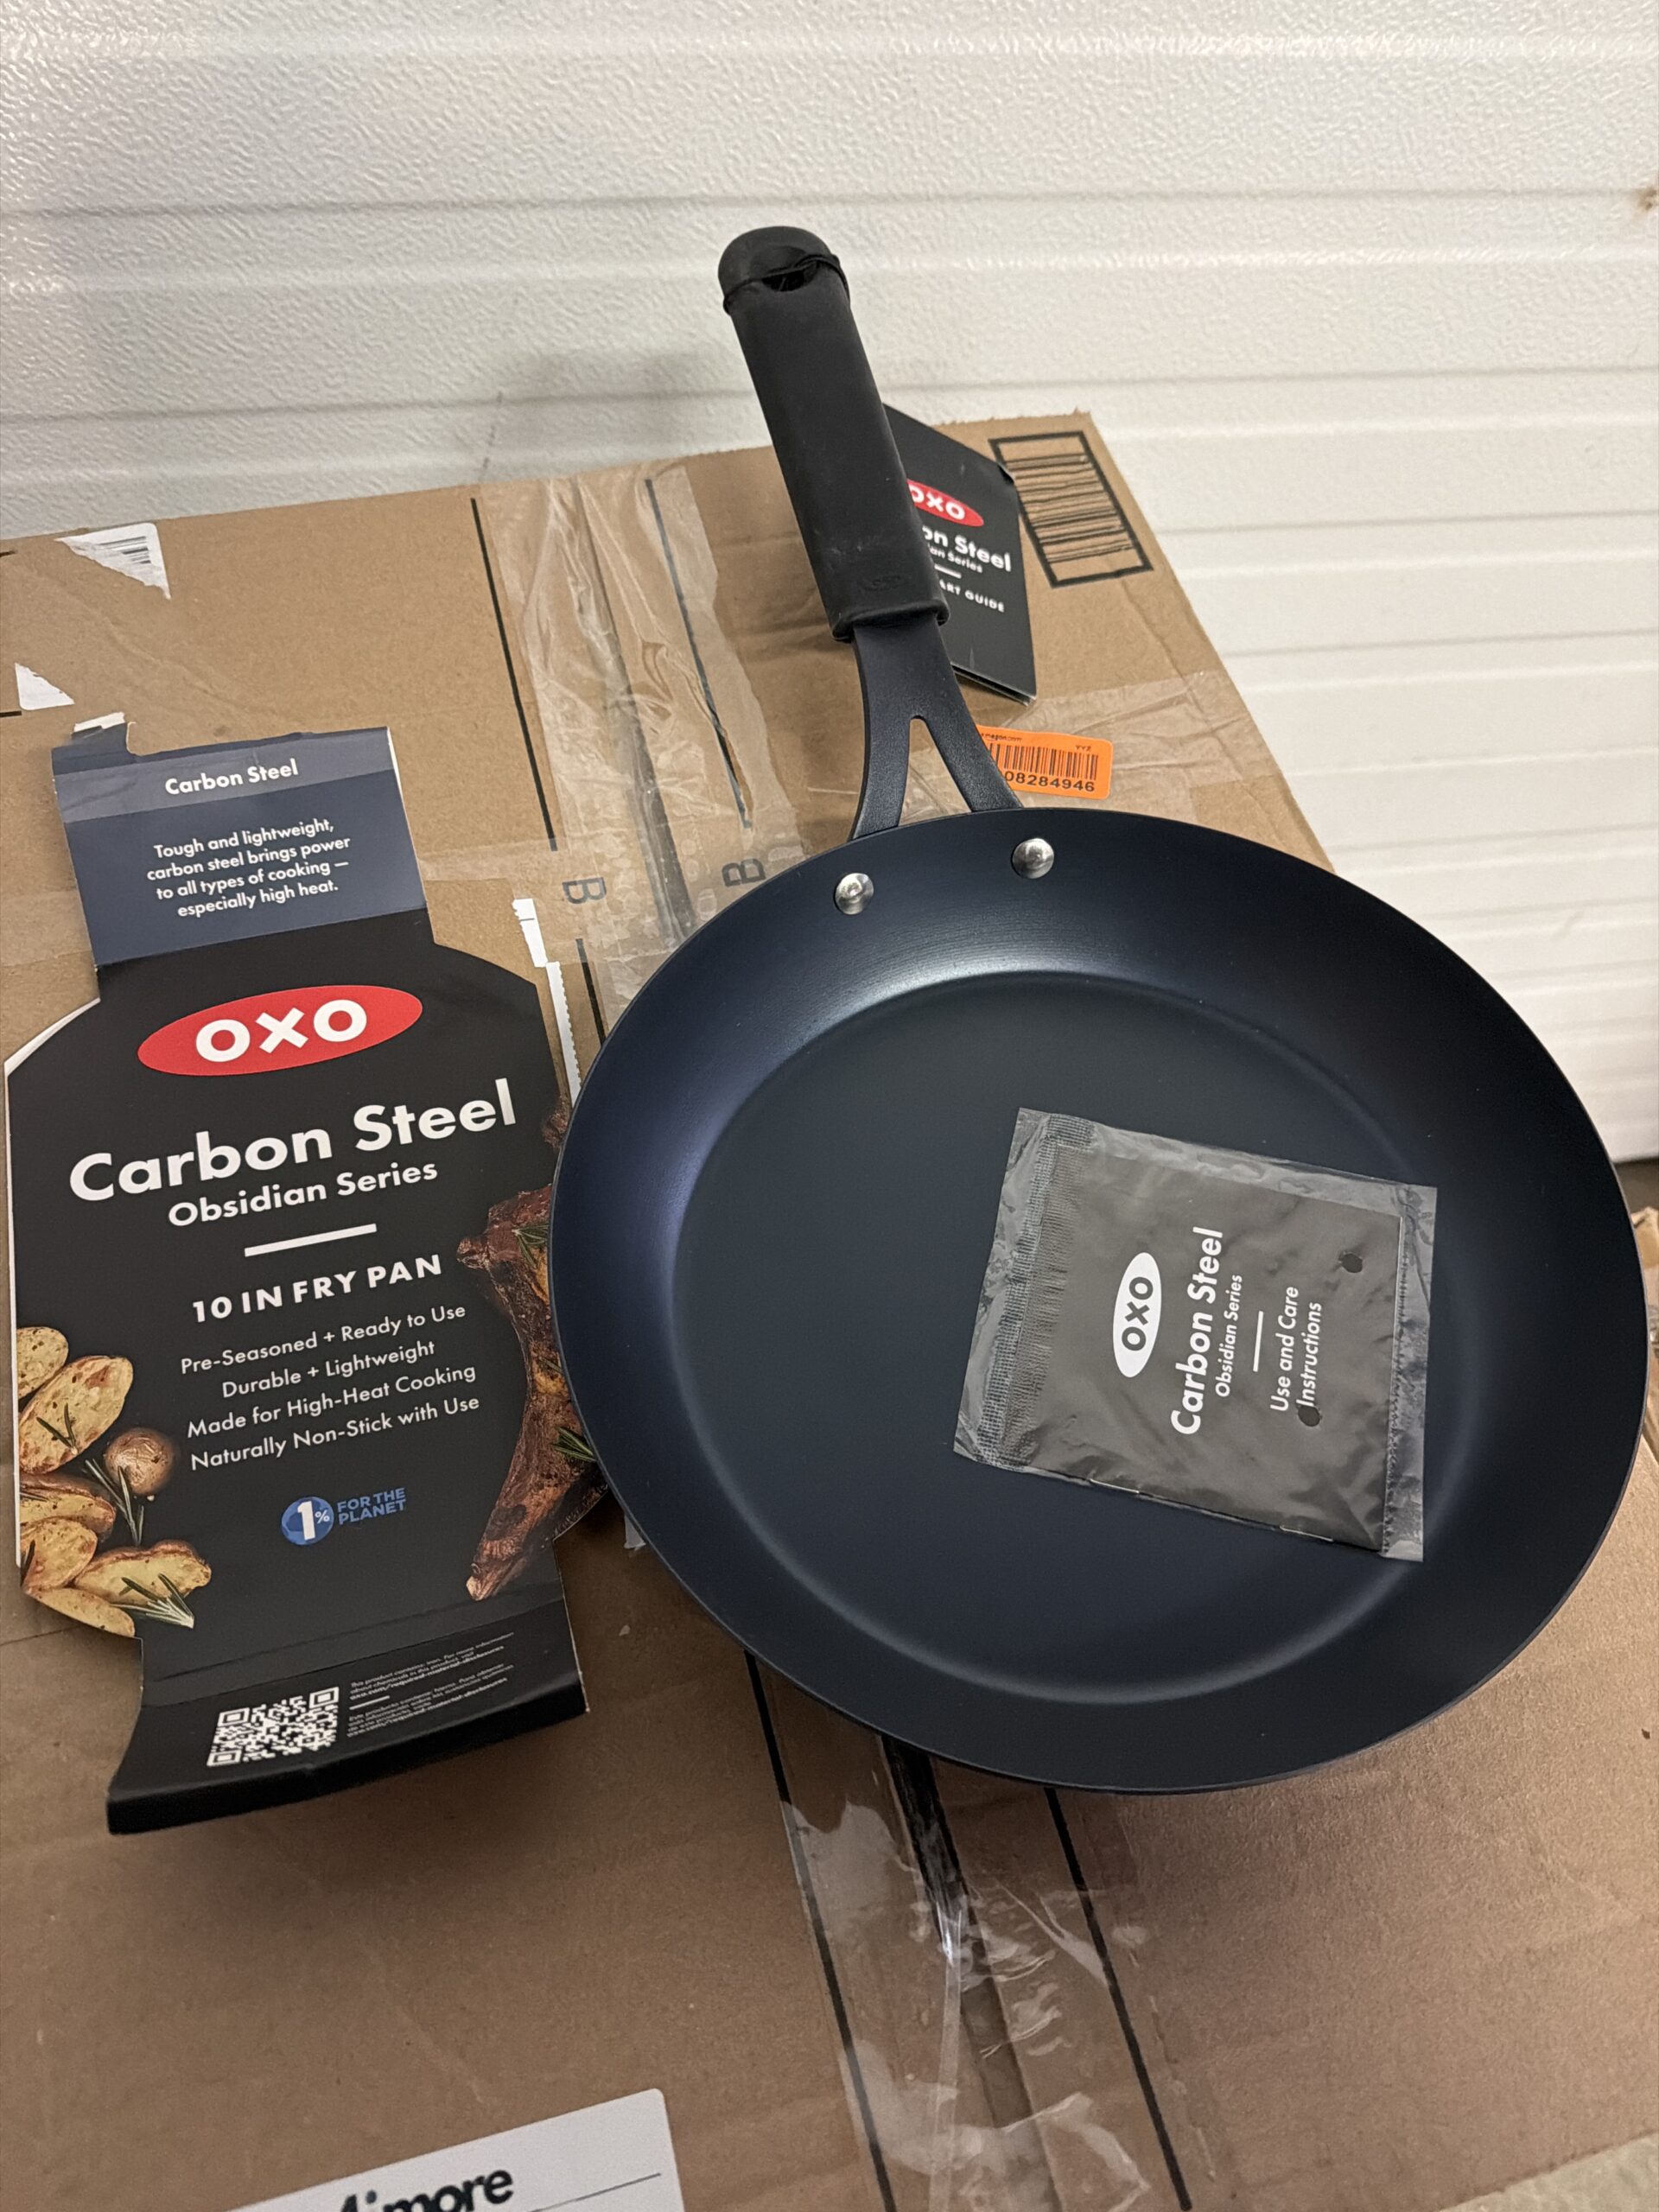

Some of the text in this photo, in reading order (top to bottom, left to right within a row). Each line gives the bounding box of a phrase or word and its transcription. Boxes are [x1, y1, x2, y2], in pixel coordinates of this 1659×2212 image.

[948, 550, 983, 573] Series
[955, 535, 1011, 572] Steel
[965, 590, 1005, 613] GUIDE
[165, 758, 298, 795] Carbon Steel
[147, 837, 351, 880] carbon steel brings power
[154, 817, 334, 858] Tough and lightweight,
[156, 887, 174, 900] to
[177, 880, 197, 897] all
[200, 877, 245, 895] types
[248, 868, 264, 885] of
[268, 861, 330, 881] cooking
[177, 880, 339, 918] especially high heat.
[562, 876, 607, 905] B
[195, 999, 367, 1063] OXO
[69, 1077, 517, 1202] Carbon Steel
[168, 1160, 438, 1227] Obsidian Series
[193, 1254, 442, 1323] 10 IN FRY PAN
[1122, 1276, 1154, 1351] OXO
[181, 1331, 318, 1375] Pre-Seasoned
[341, 1316, 401, 1342] Ready
[407, 1313, 426, 1328] to
[431, 1306, 466, 1322] Use
[1171, 1226, 1223, 1435] Carbon Steel
[1215, 1274, 1243, 1397] Obsidian Series
[1270, 1286, 1299, 1411] Use and Care
[1296, 1301, 1322, 1407] Instructions
[222, 1369, 302, 1398] Durable
[326, 1340, 435, 1378] Lightweight
[187, 1366, 476, 1439] Made for High-Heat Cooking
[191, 1397, 480, 1471] Naturally Non-Stick with Use
[336, 1487, 406, 1512] FOR THE
[338, 1499, 407, 1525] PLANET
